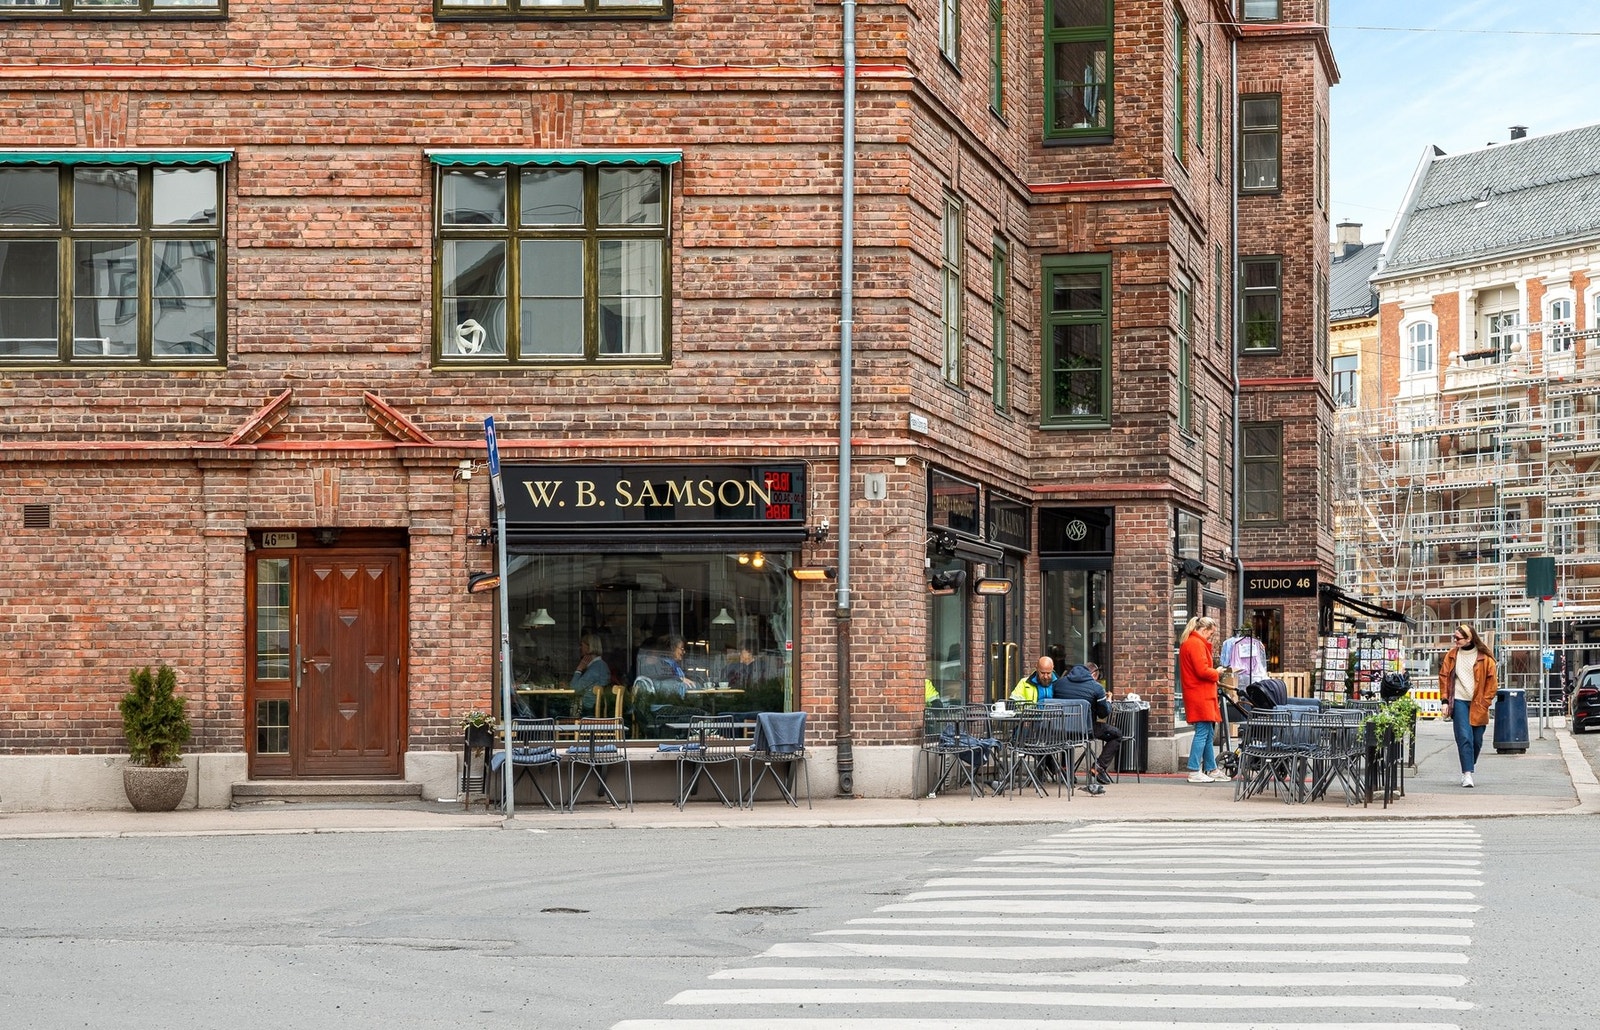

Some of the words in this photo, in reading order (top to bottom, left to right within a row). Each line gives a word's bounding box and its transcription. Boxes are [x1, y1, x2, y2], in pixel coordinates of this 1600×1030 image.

[522, 480, 565, 508] W.
[575, 480, 606, 507] B.
[614, 479, 774, 508] SAMSON
[264, 533, 277, 546] 46
[1250, 579, 1292, 589] STUDIO
[1296, 578, 1310, 588] 46
